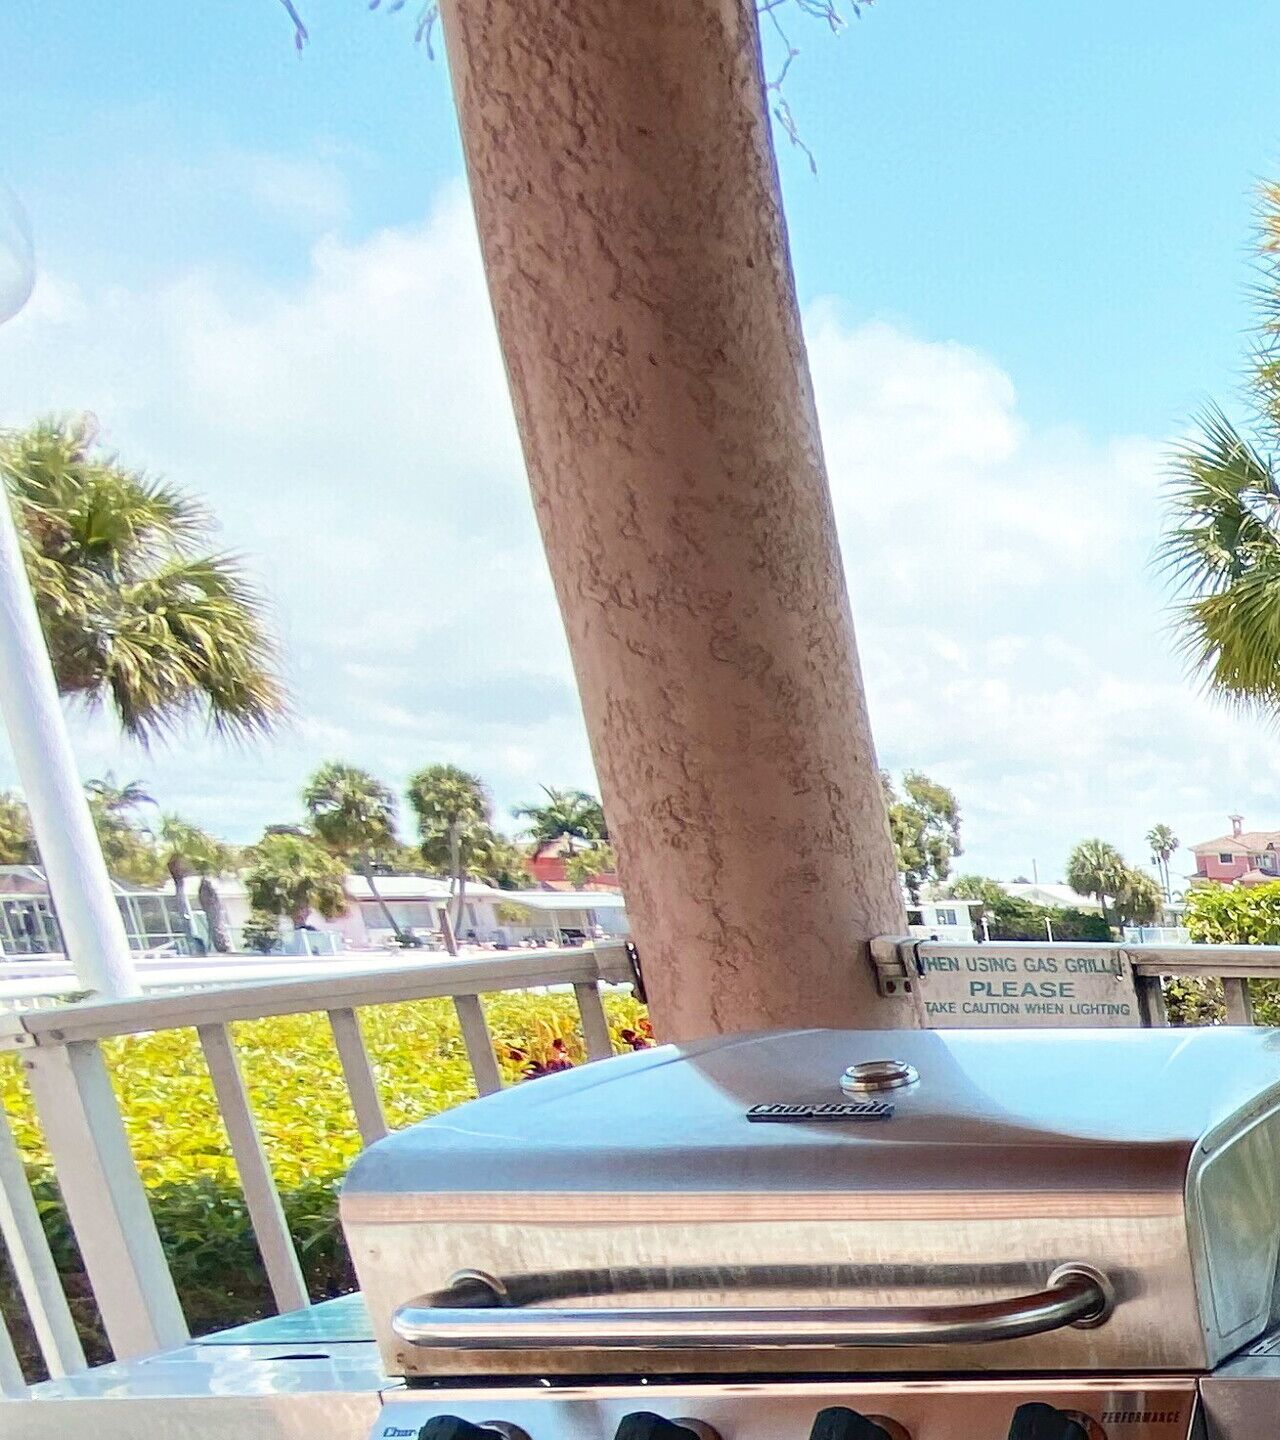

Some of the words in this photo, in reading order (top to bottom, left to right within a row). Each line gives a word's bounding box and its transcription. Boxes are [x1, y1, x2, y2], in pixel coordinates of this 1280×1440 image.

[966, 957, 1017, 972] USING
[1024, 958, 1058, 973] GAS
[969, 981, 1075, 998] PLEASE
[924, 1002, 957, 1014] TAKE
[962, 1003, 1019, 1014] CAUTION
[1025, 1003, 1064, 1015] WHEN
[1069, 1004, 1130, 1016] LIGHTING
[1101, 1411, 1181, 1423] PERFORMANCE
